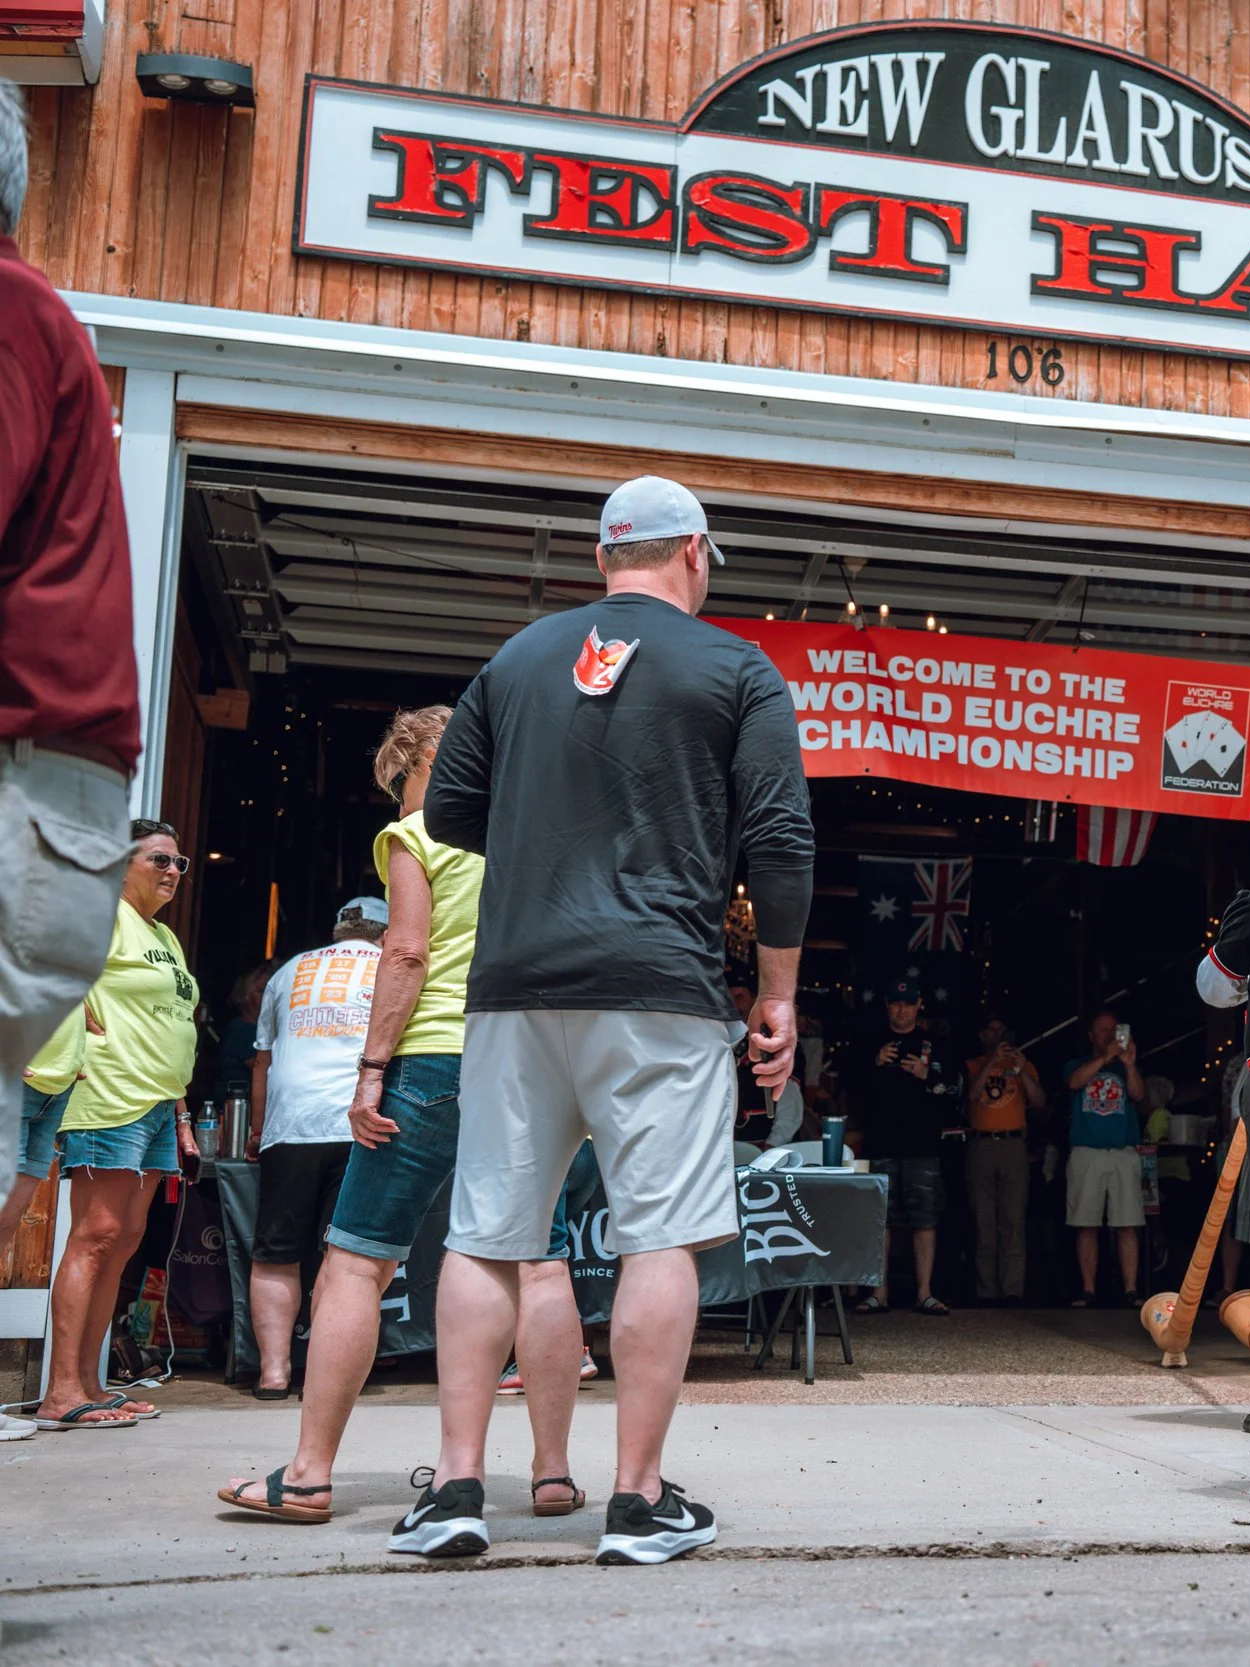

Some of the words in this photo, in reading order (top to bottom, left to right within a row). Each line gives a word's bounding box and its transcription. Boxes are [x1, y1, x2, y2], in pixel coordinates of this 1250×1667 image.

[758, 51, 945, 147] NEW
[367, 126, 970, 285] FEST
[986, 341, 1065, 386] 106
[608, 522, 633, 540] Twins
[806, 649, 997, 690] WELCOME
[1004, 666, 1052, 695] TO
[1059, 672, 1127, 704] THE
[1187, 687, 1232, 701] WORLD
[786, 680, 953, 724] WORLD
[964, 696, 1141, 745] EUCHRE
[1182, 696, 1234, 711] EUCHRE
[798, 719, 1135, 781] CHAMPIONSHIP
[1164, 775, 1239, 792] FEDERATION
[785, 1174, 816, 1228] TRUSTED
[574, 1267, 615, 1278] SINCE
